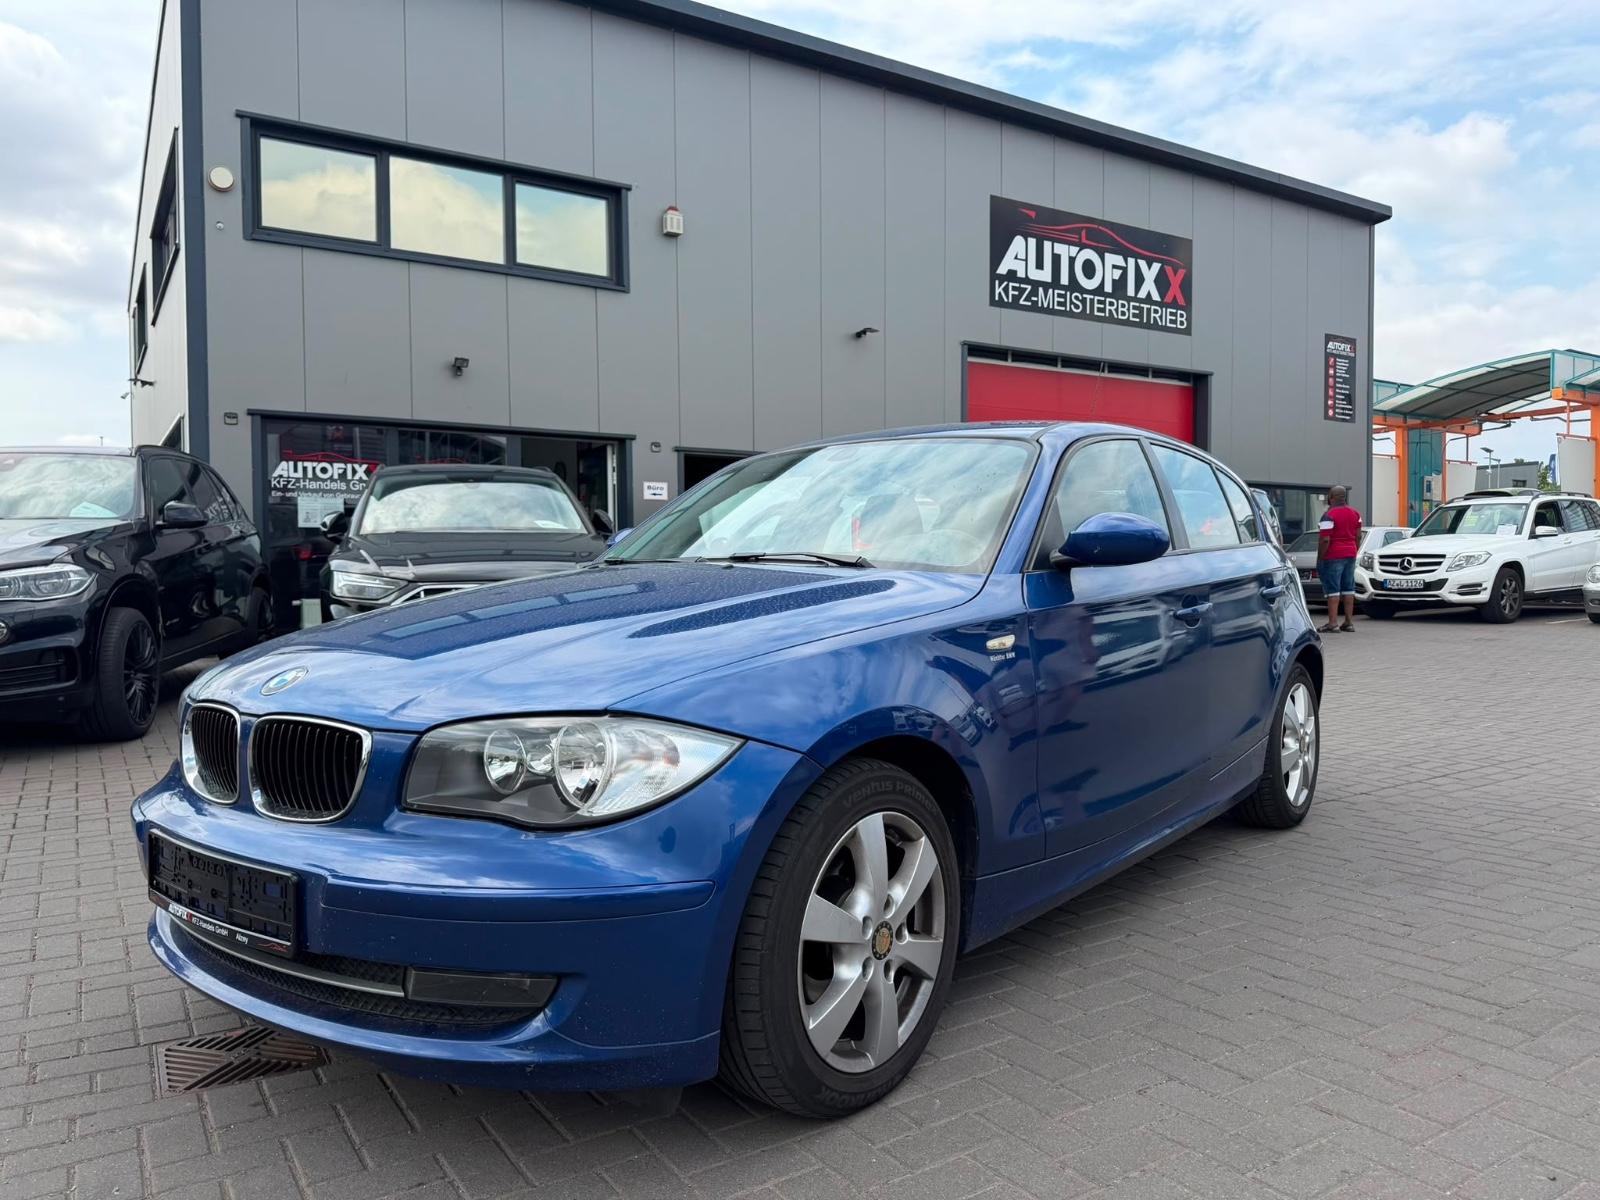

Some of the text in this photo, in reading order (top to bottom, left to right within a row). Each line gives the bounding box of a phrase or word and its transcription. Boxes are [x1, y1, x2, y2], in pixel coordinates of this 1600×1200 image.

[995, 235, 1187, 306] AUTOFIXX
[995, 279, 1187, 329] KFZ-MEISTERBETRIEB
[271, 478, 346, 490] KFZ-Handels
